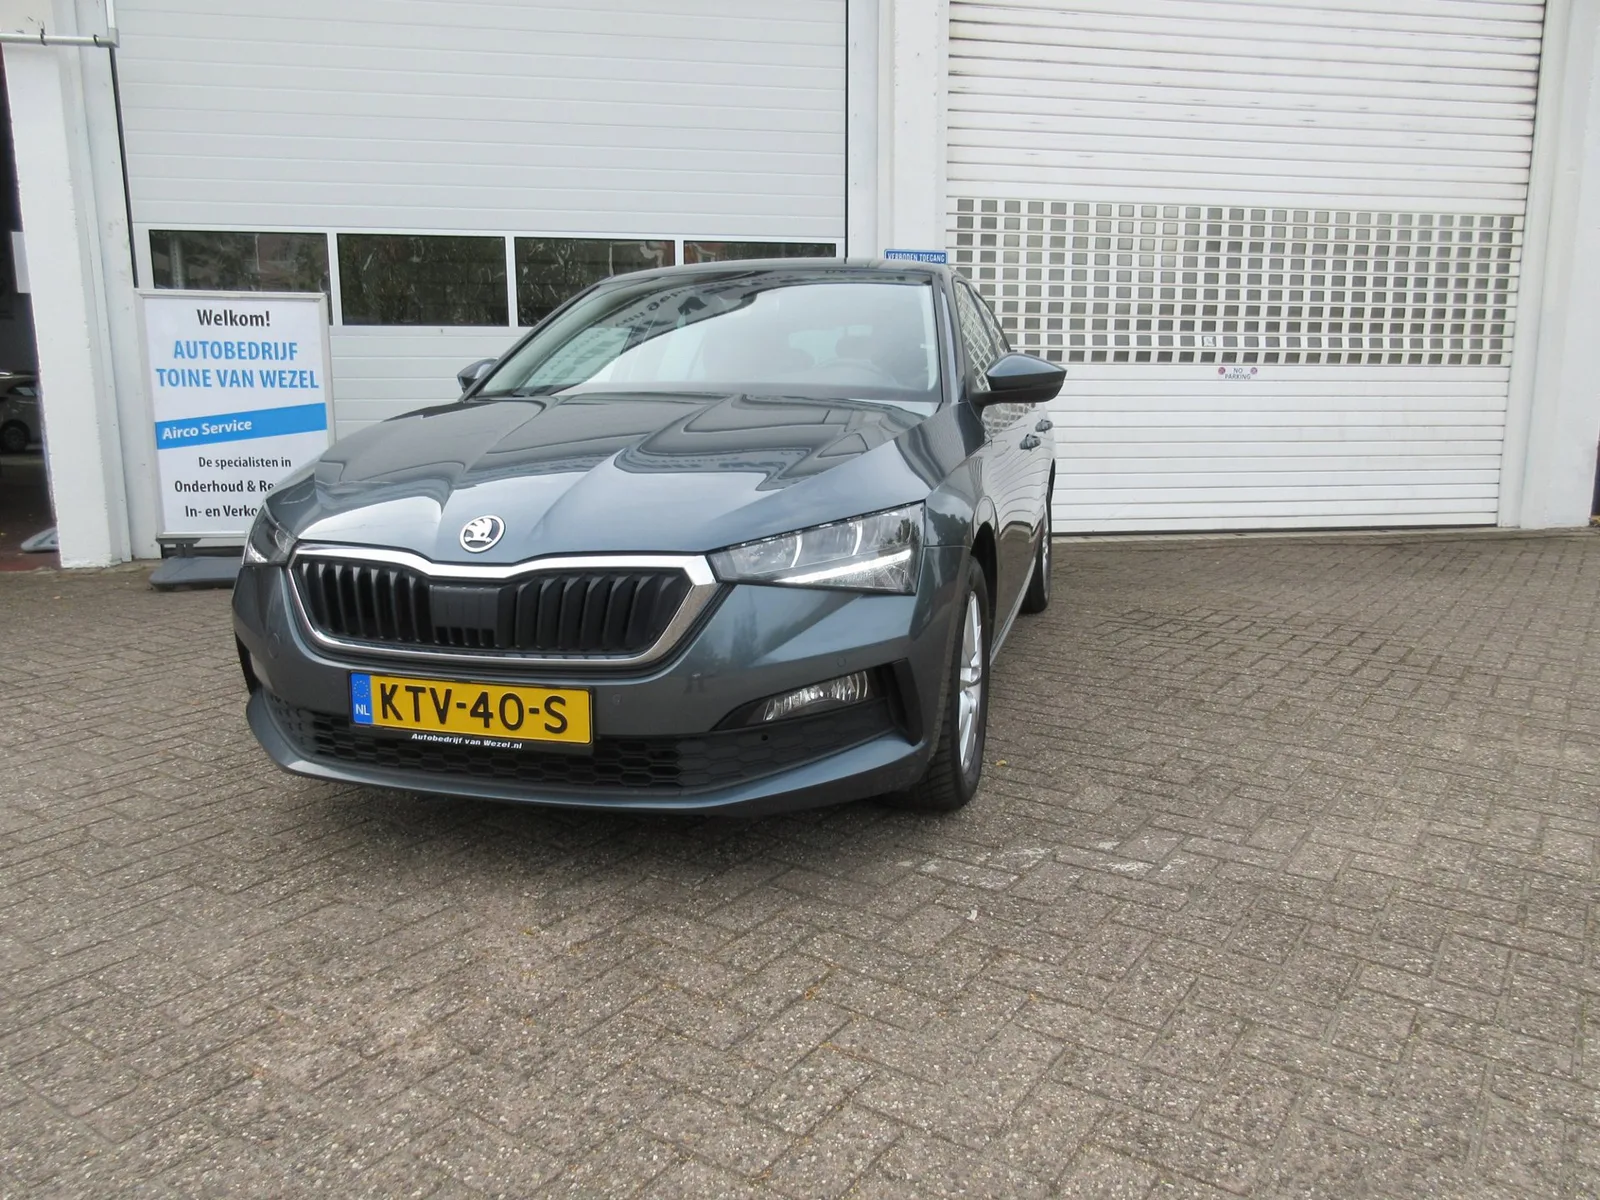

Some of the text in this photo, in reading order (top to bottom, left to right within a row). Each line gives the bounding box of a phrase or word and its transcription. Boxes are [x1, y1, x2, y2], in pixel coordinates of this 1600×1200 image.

[887, 253, 945, 263] VERBODEN TOEGANG
[197, 309, 271, 327] Welkom!
[174, 340, 298, 361] AUTOBEDRIJF
[156, 368, 319, 389] TOINE VAN WEZEL
[162, 420, 252, 440] Airco Service
[199, 457, 292, 470] De specialisten in
[175, 481, 276, 492] Onderhoud & Re
[185, 506, 202, 518] In-
[206, 509, 220, 518] en
[356, 703, 370, 716] NL
[380, 683, 569, 734] KTV-40-S
[412, 733, 522, 749] Autobedrijf van Wezel.nl
